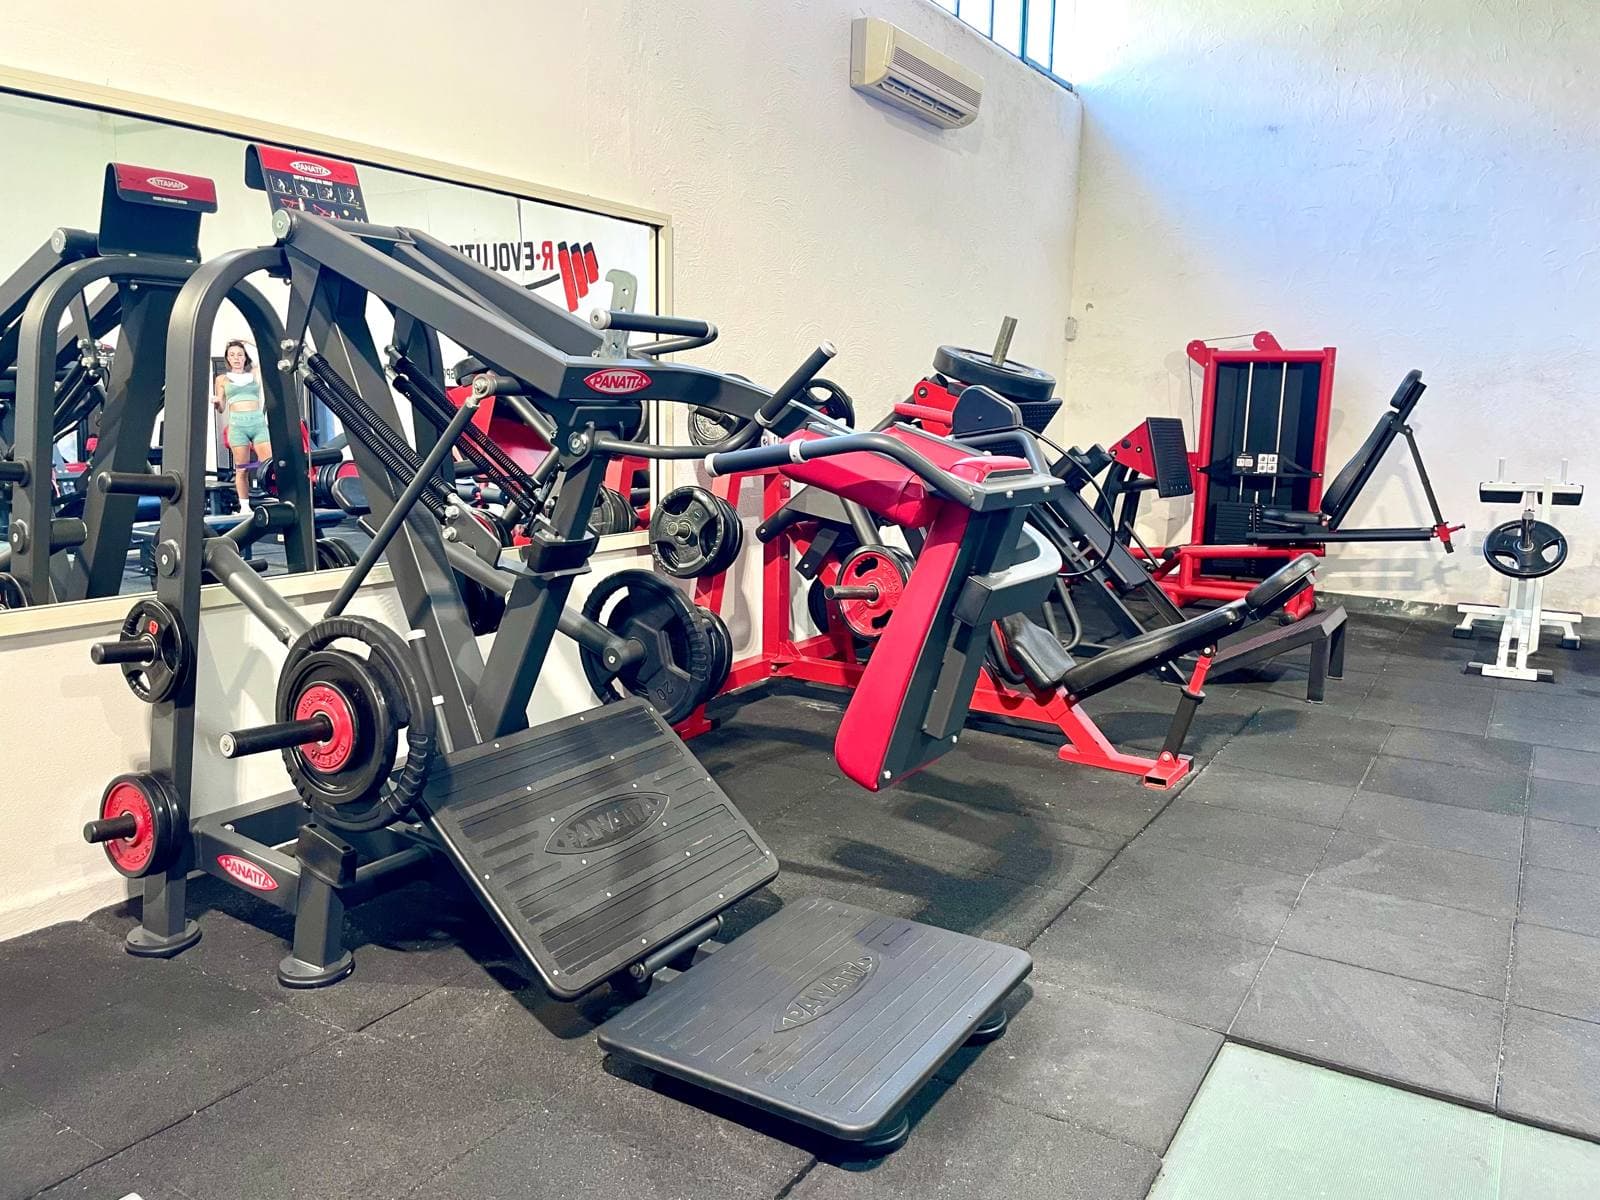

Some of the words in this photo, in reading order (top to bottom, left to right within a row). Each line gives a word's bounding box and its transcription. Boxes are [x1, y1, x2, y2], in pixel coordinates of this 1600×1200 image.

[593, 375, 644, 388] PANATTA
[566, 799, 656, 848] PANATTA
[224, 857, 270, 887] PANATTA
[786, 958, 871, 1018] PANATTA
